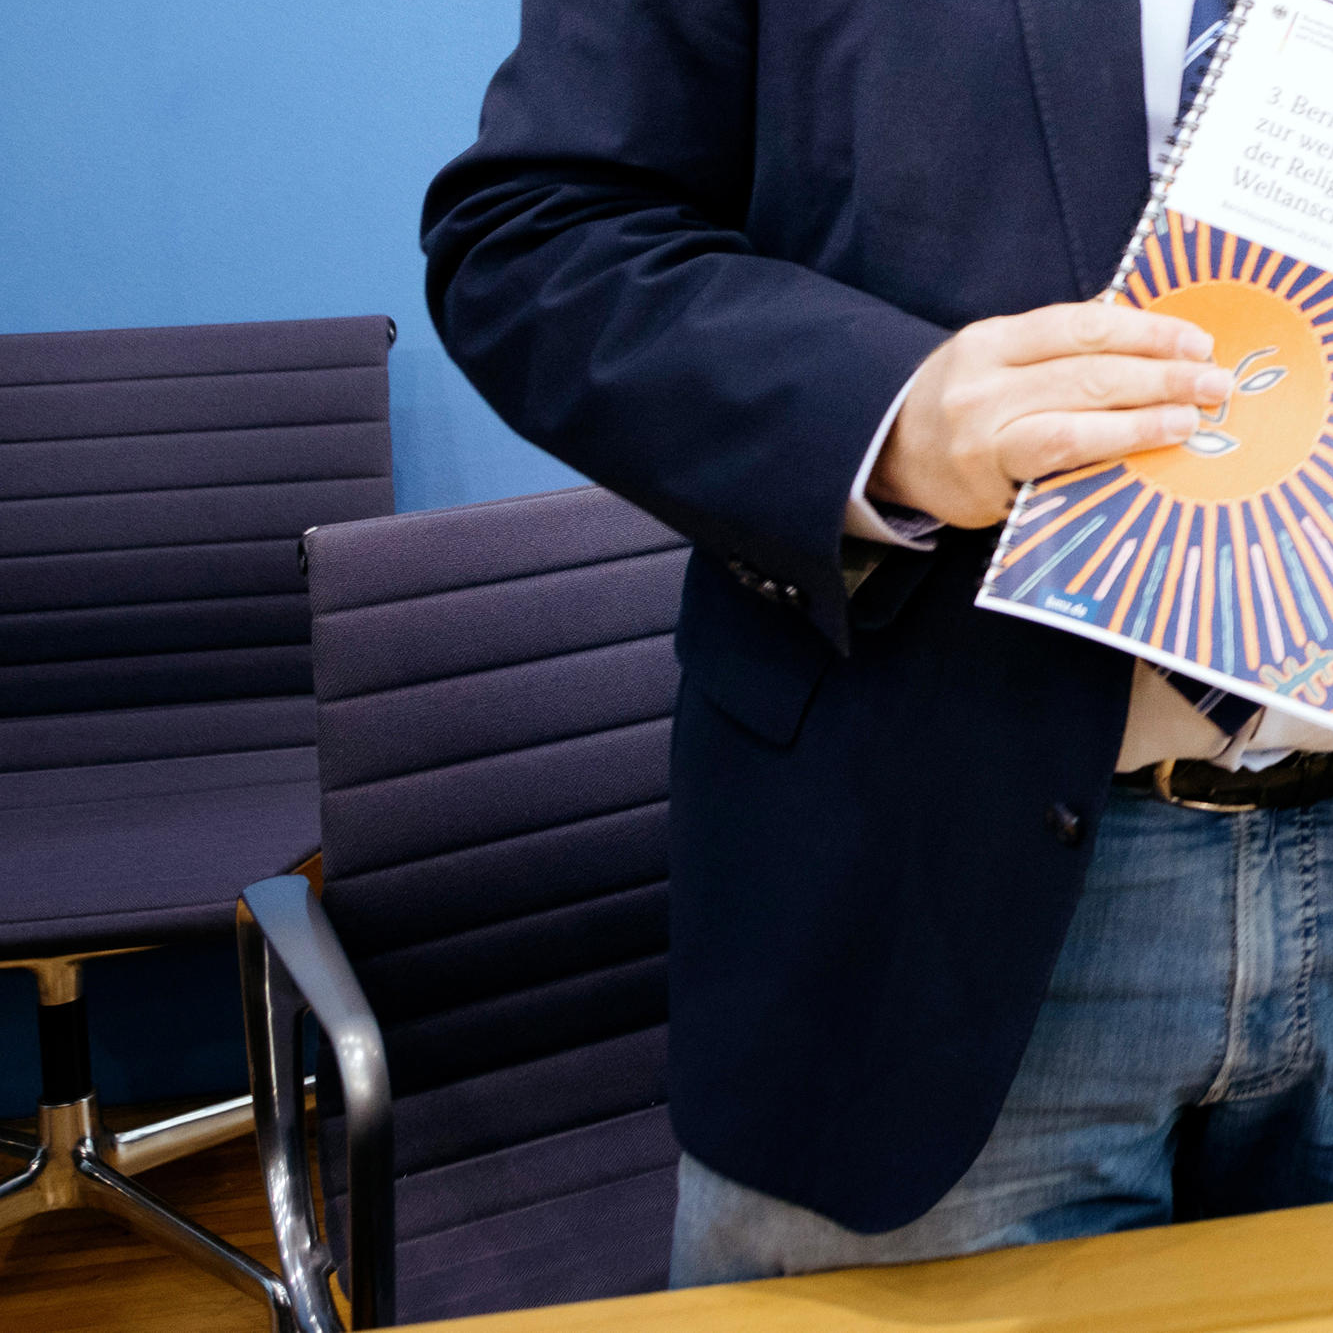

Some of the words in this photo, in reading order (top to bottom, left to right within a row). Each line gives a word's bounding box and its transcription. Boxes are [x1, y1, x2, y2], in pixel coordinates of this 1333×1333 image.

[1266, 85, 1284, 108] 3.
[1255, 117, 1296, 142] zur
[1243, 141, 1283, 169] der
